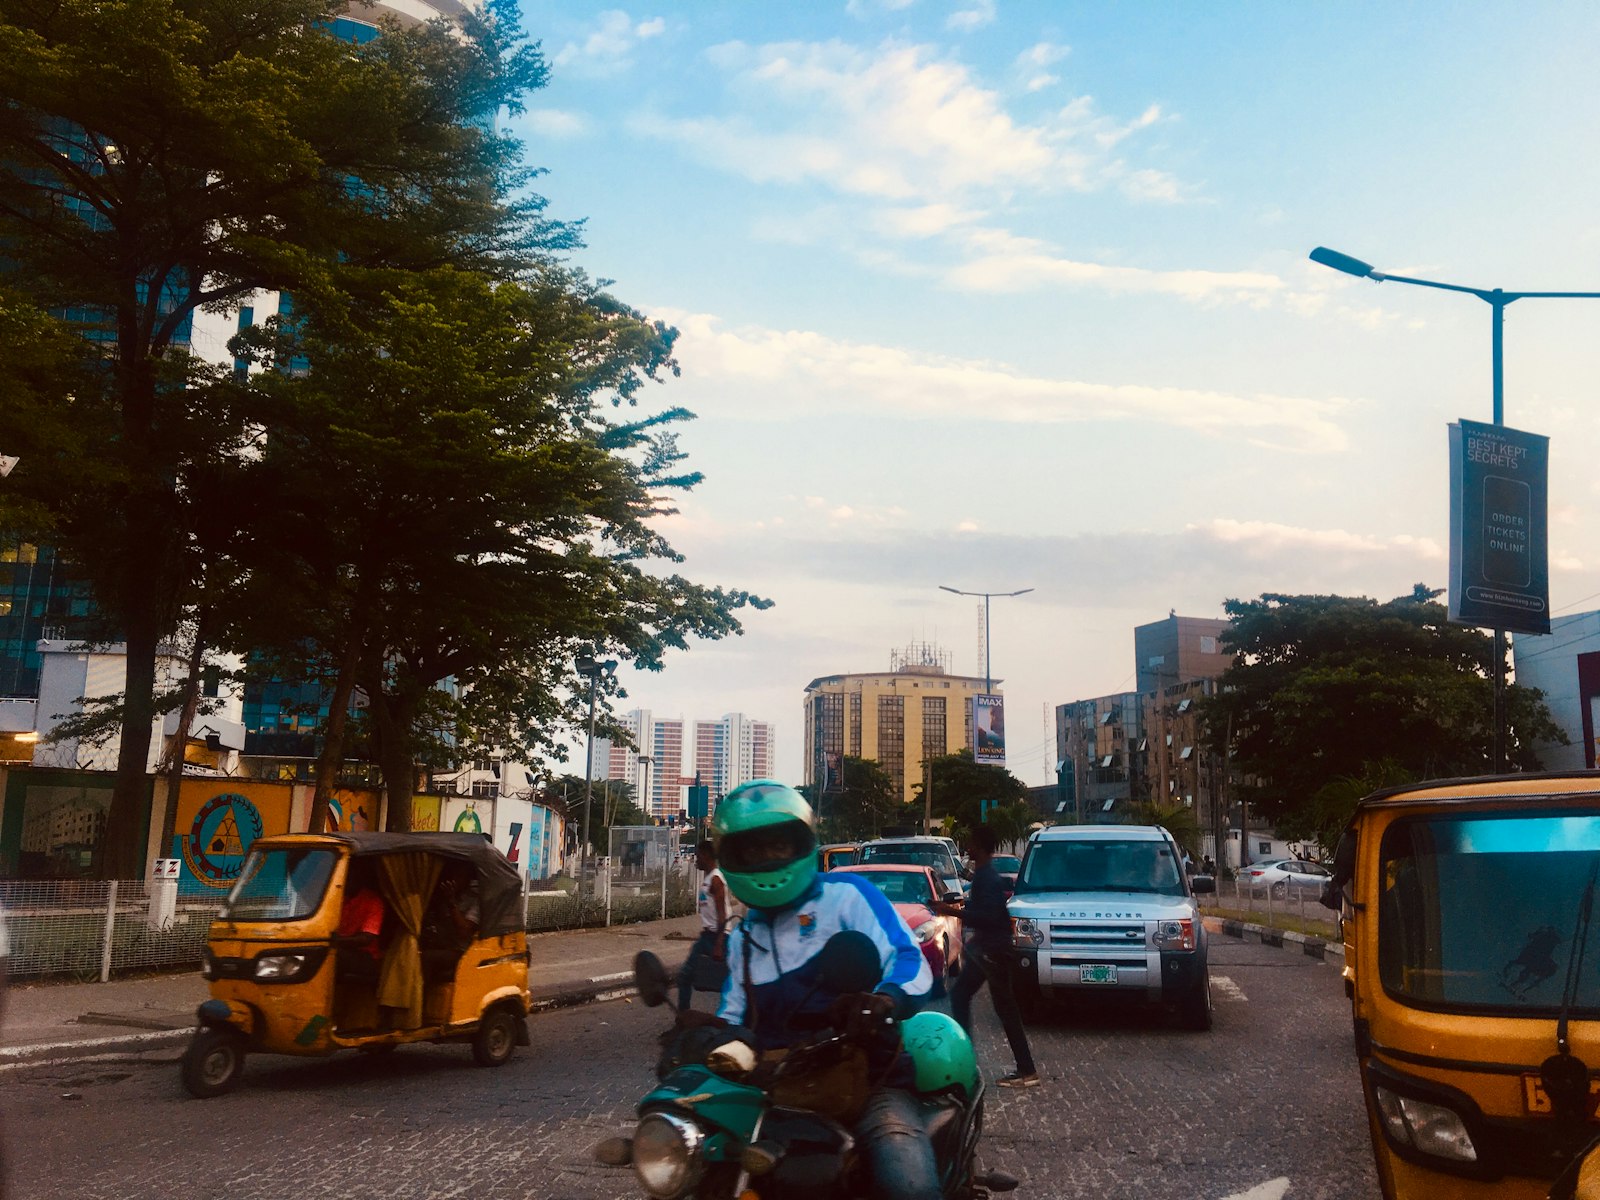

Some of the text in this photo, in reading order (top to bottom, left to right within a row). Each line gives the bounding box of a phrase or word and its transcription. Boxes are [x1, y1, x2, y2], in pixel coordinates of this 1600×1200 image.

[1468, 438, 1528, 459] BEST KEPT
[1467, 449, 1519, 469] SECRETS
[1492, 512, 1524, 526] ORDER
[1488, 525, 1526, 541] TICKETS
[1490, 539, 1525, 553] ONLINE
[979, 698, 1002, 706] IMAX
